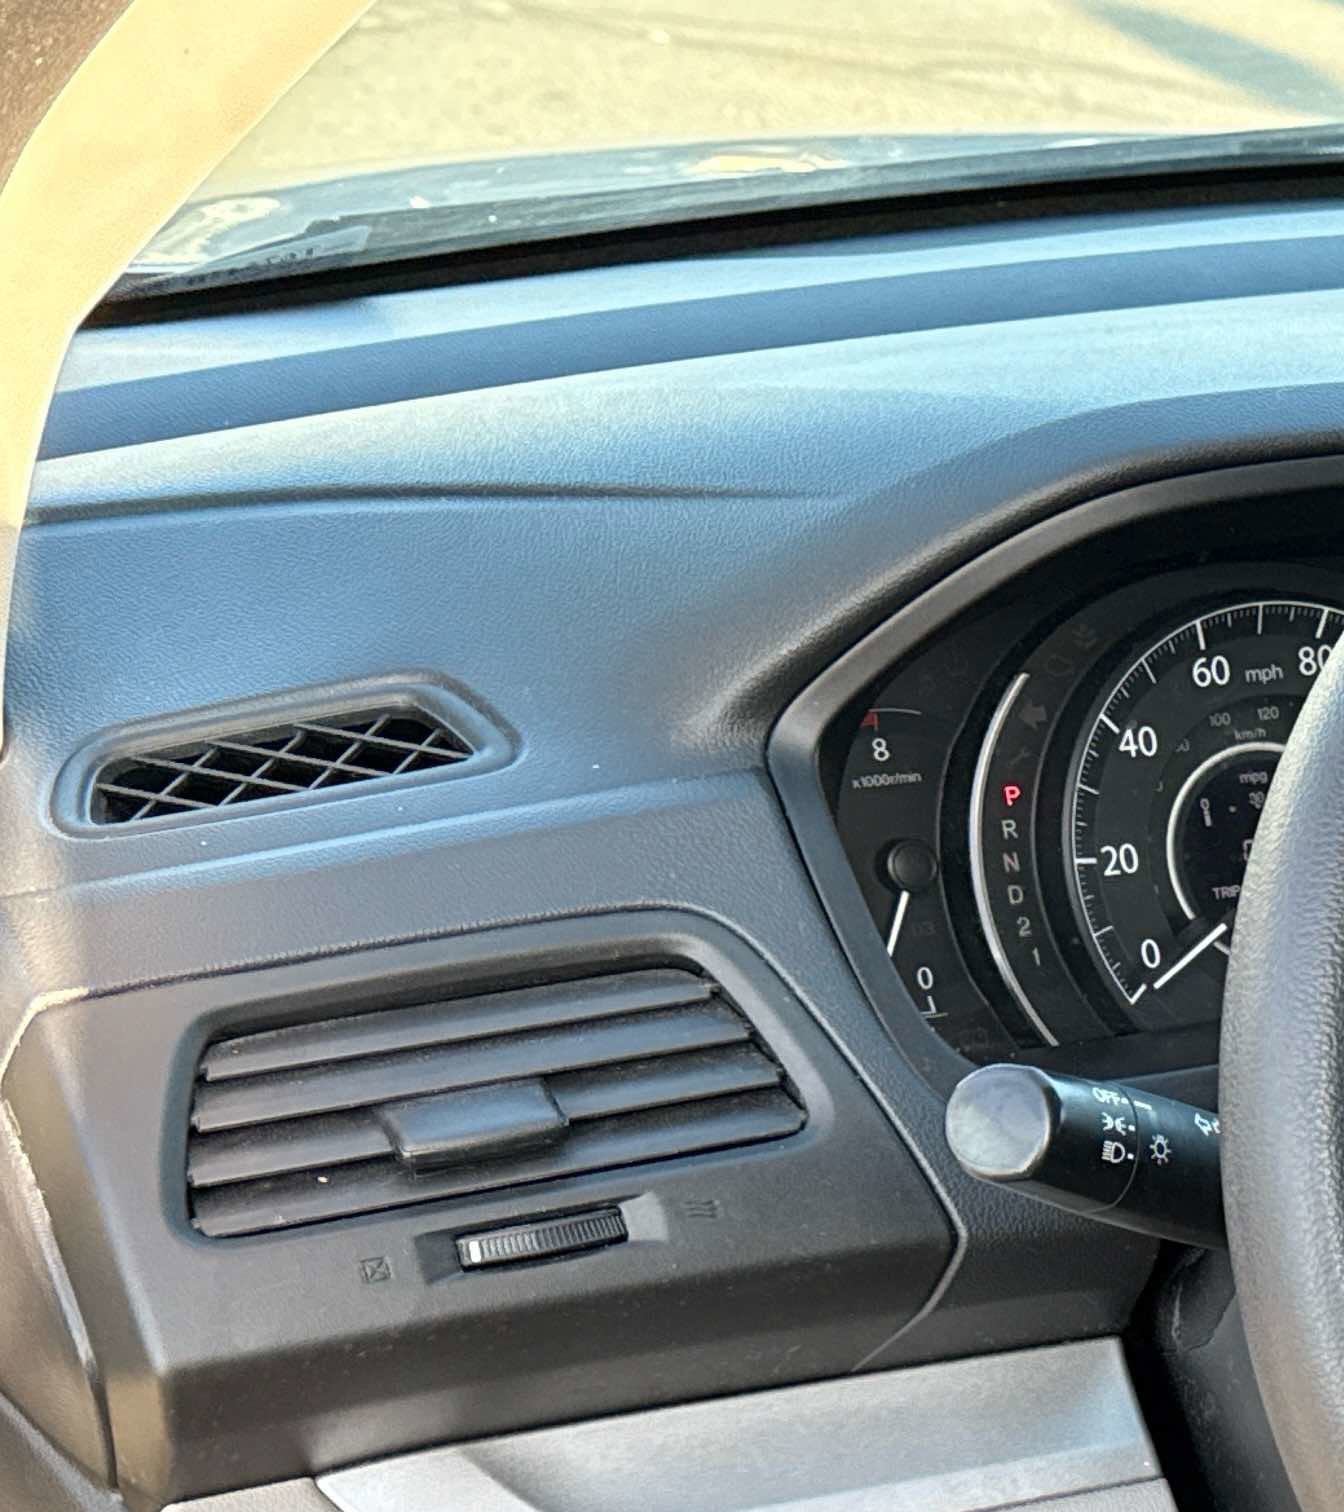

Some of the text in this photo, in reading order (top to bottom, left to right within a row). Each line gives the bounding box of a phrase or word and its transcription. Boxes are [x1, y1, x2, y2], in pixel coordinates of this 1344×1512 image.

[1192, 655, 1284, 688] 60 mph
[1209, 712, 1232, 727] 100
[1257, 706, 1280, 721] 120
[1118, 725, 1158, 758] 40
[1234, 728, 1267, 741] km/h
[871, 737, 891, 762] 8
[1239, 771, 1269, 786] mpg
[1003, 785, 1021, 806] P
[1002, 819, 1019, 840] R
[1002, 851, 1020, 873] N
[1100, 843, 1139, 876] 20
[1007, 884, 1024, 906] D
[1016, 916, 1033, 938] 2
[1032, 948, 1041, 966] 1
[1141, 938, 1161, 969] 0
[916, 966, 934, 990] 0
[1092, 1086, 1121, 1106] OFF
